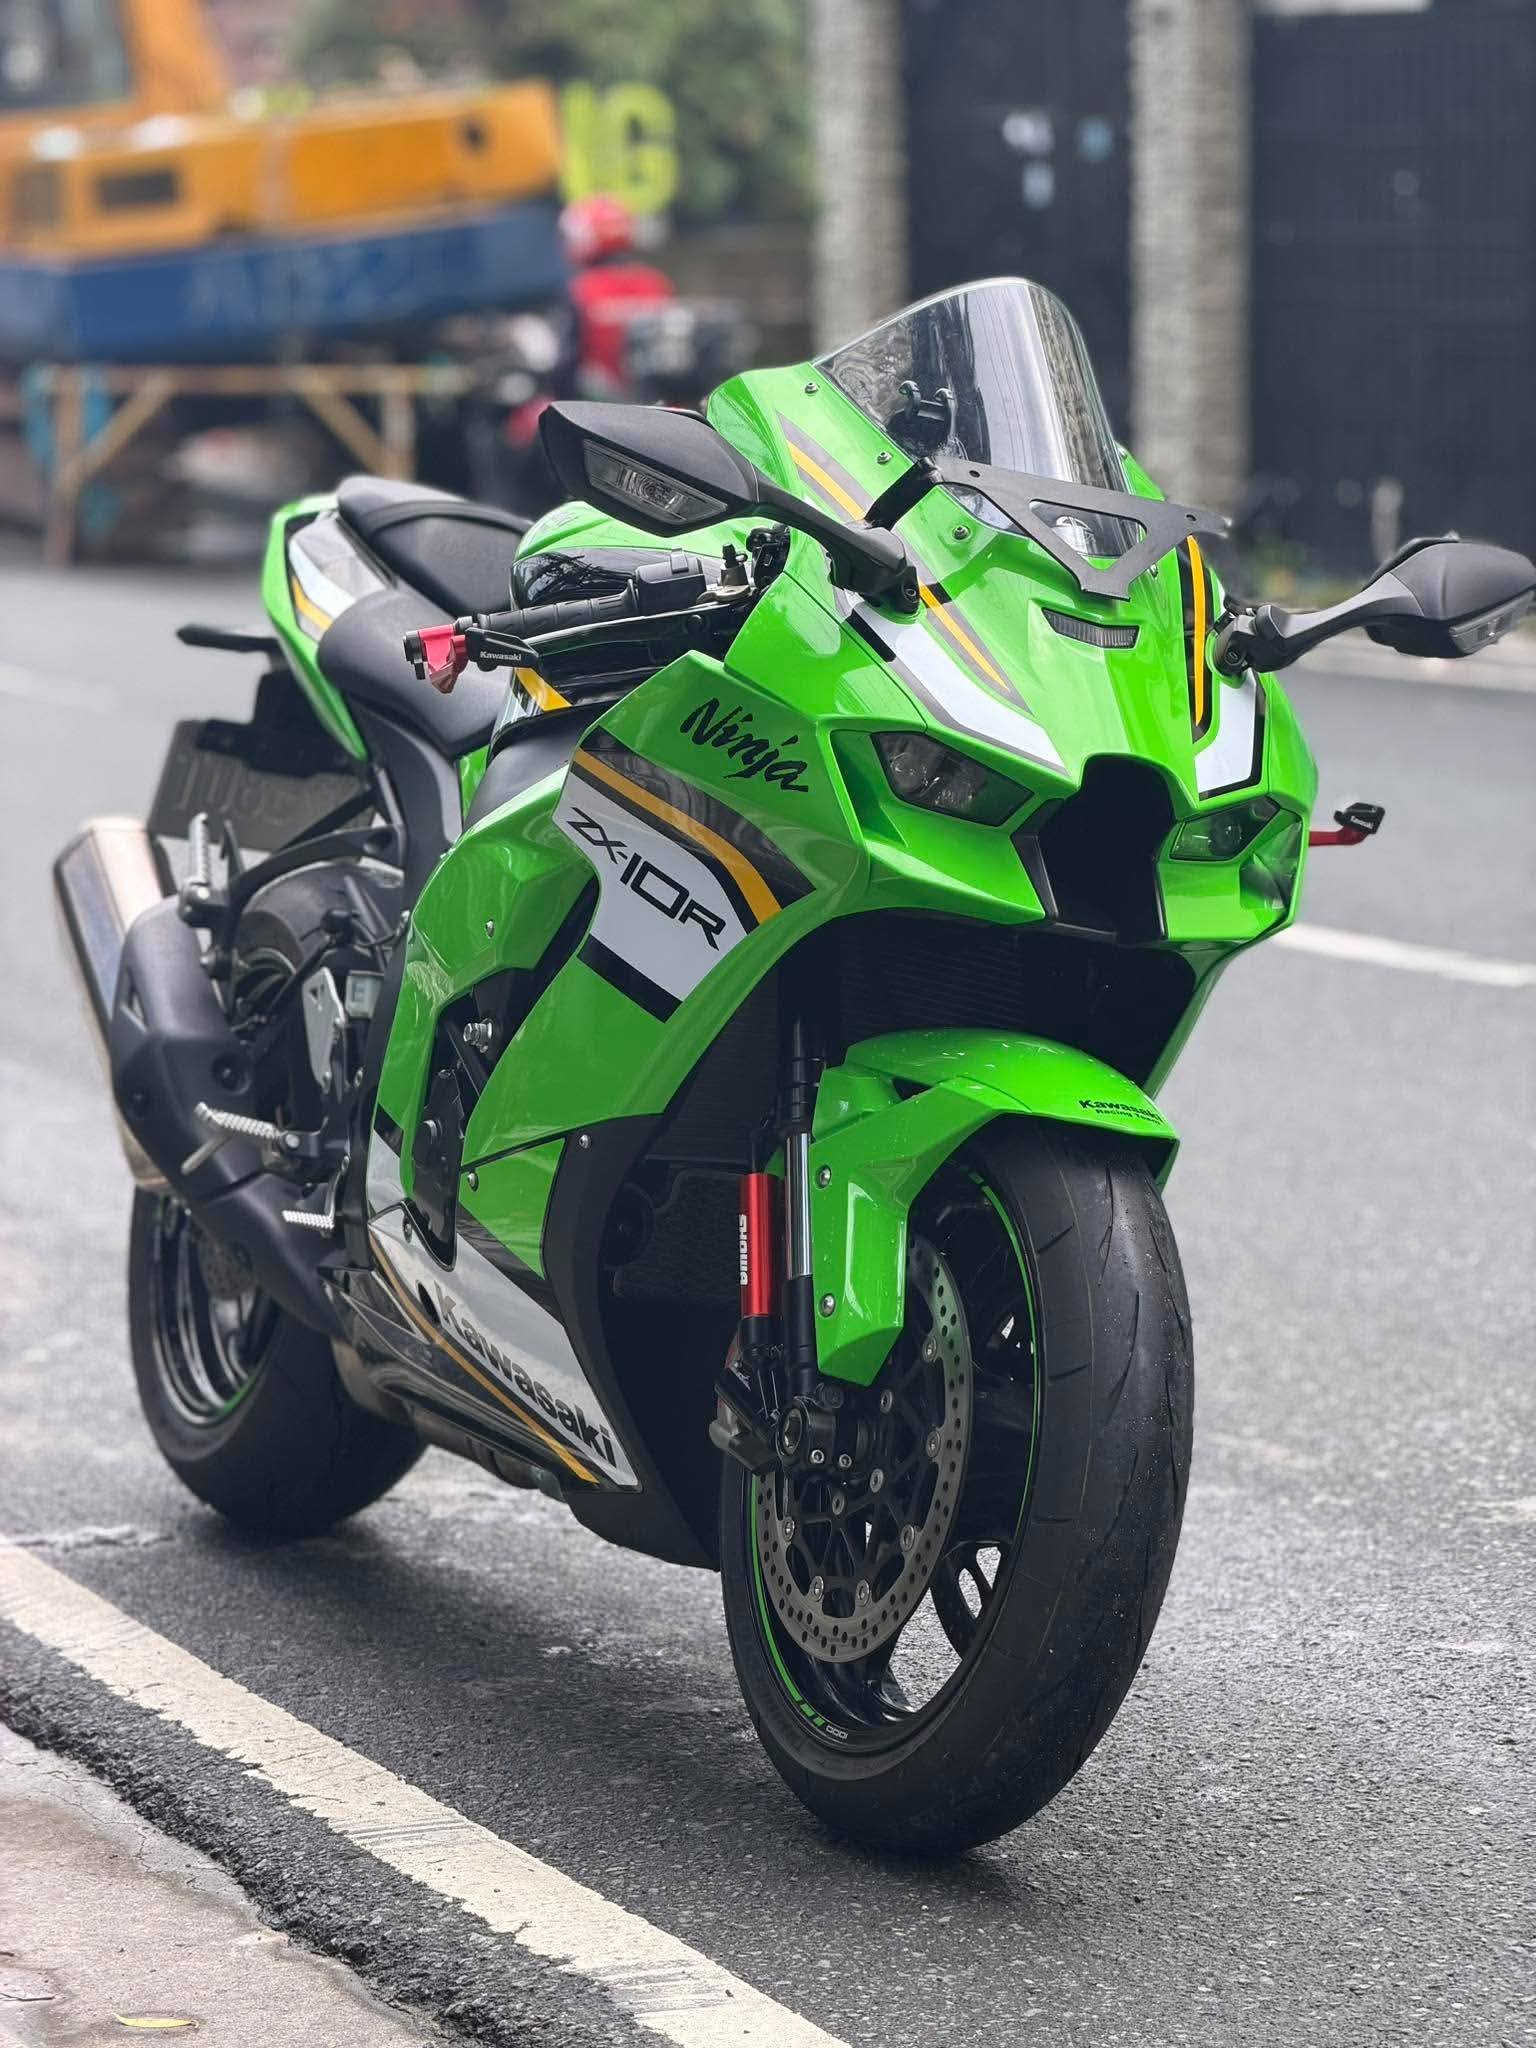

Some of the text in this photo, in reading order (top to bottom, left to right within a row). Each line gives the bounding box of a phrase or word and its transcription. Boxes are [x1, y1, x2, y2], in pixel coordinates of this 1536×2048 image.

[480, 651, 521, 661] Kawasaki
[680, 698, 808, 792] Ninja
[567, 807, 726, 951] ZX-10R
[1079, 1099, 1165, 1124] Kawasaki
[739, 1214, 748, 1285] SHOWA
[434, 1280, 617, 1468] Kawasaki
